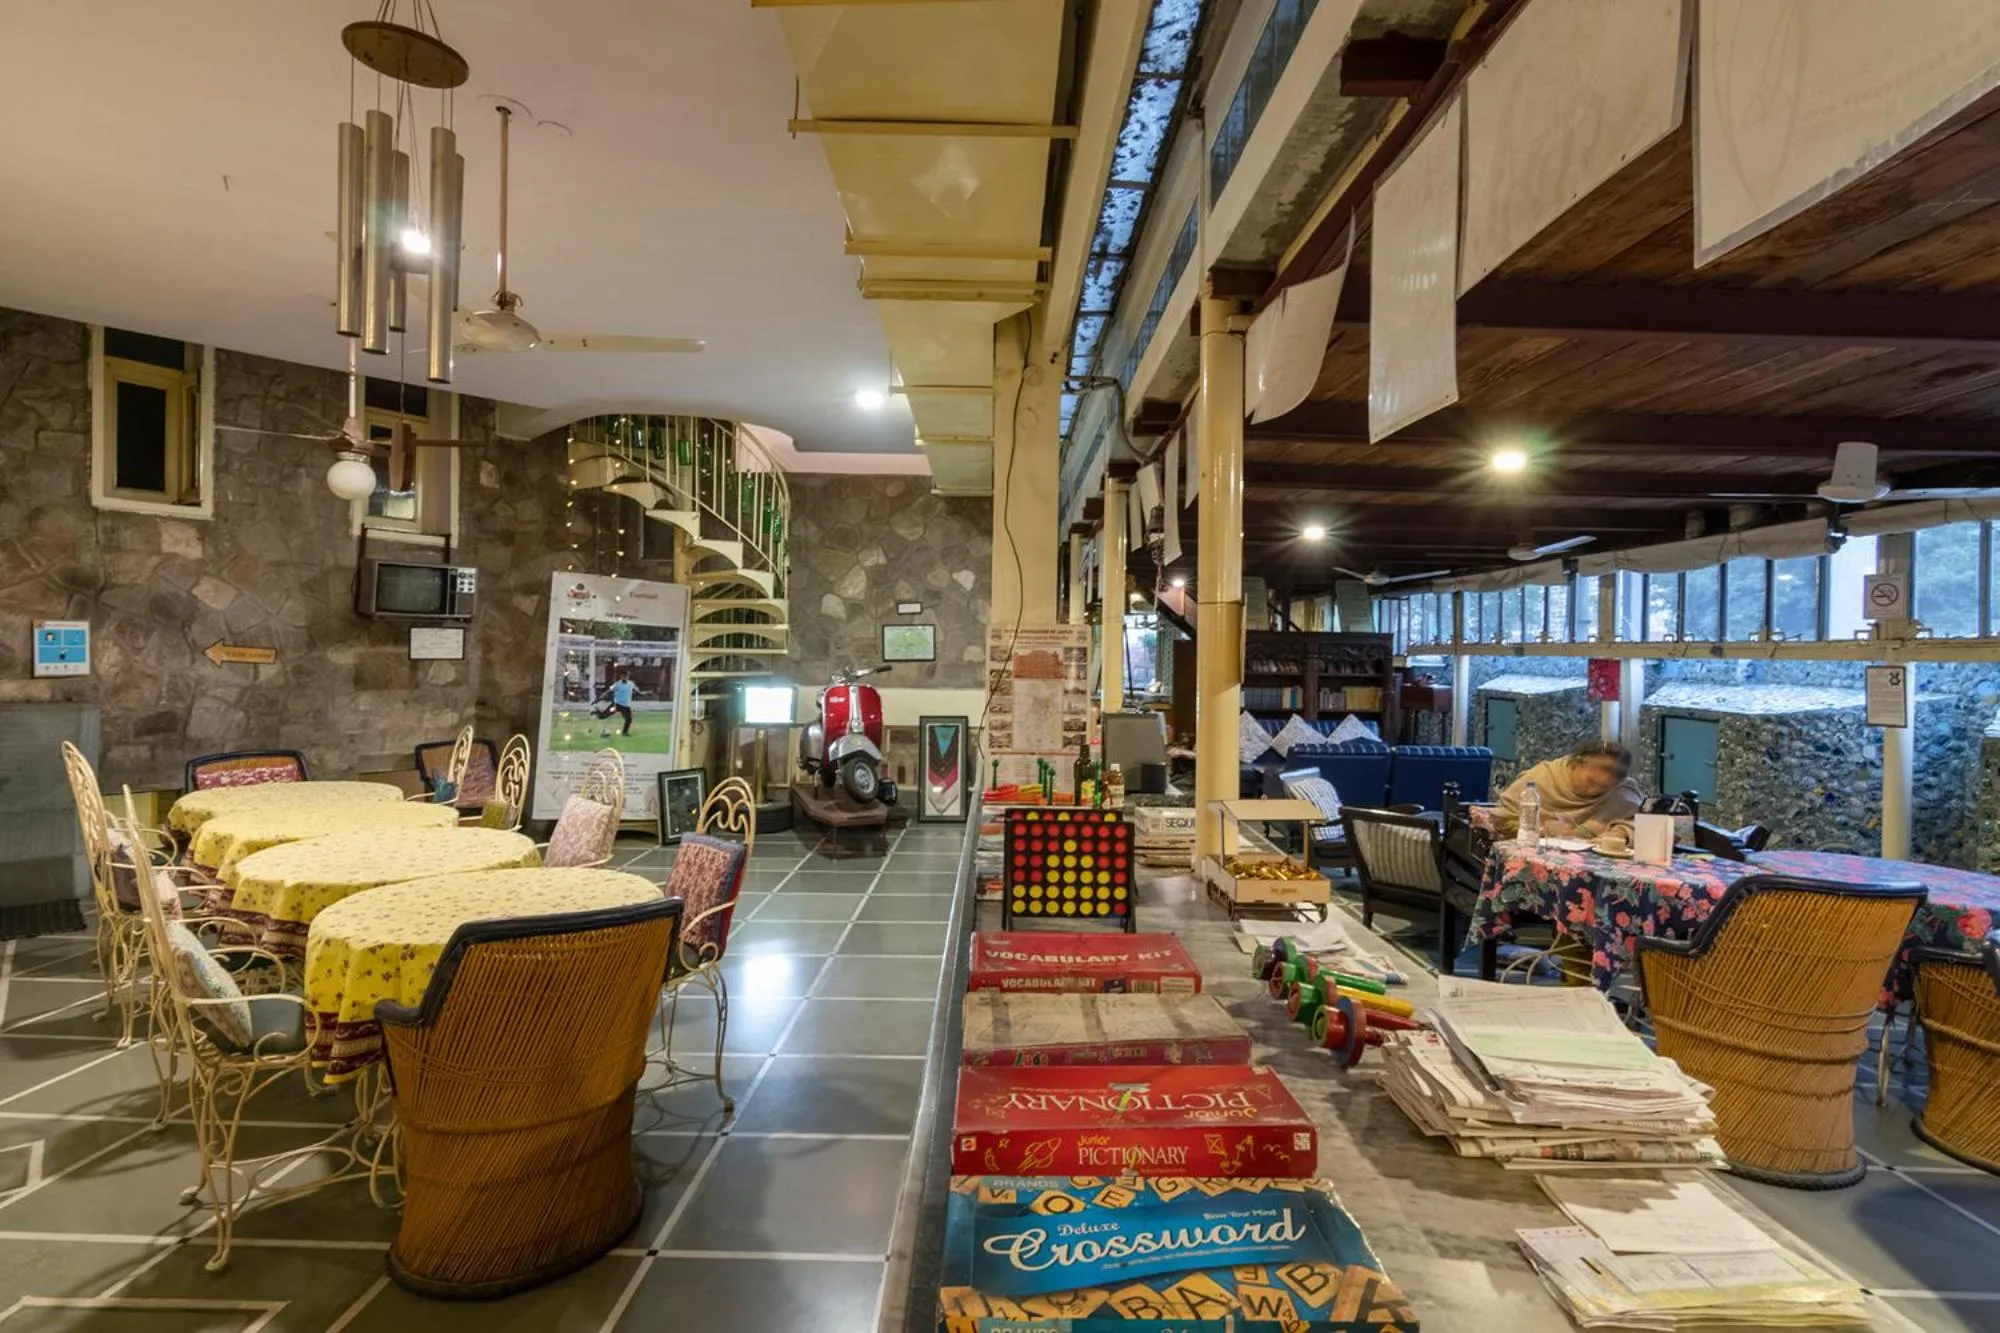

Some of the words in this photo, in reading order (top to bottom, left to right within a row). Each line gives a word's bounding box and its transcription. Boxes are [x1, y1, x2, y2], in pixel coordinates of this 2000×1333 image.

[985, 949, 1129, 964] VOCABULARY
[1138, 949, 1172, 961] KIT
[1003, 1091, 1249, 1113] PICTIONARY
[1183, 1106, 1258, 1119] Junior
[1077, 1134, 1110, 1148] Junior
[1078, 1146, 1189, 1166] PICTIONARY
[1057, 1221, 1120, 1237] Deluxe
[983, 1207, 1306, 1271] Crossword
